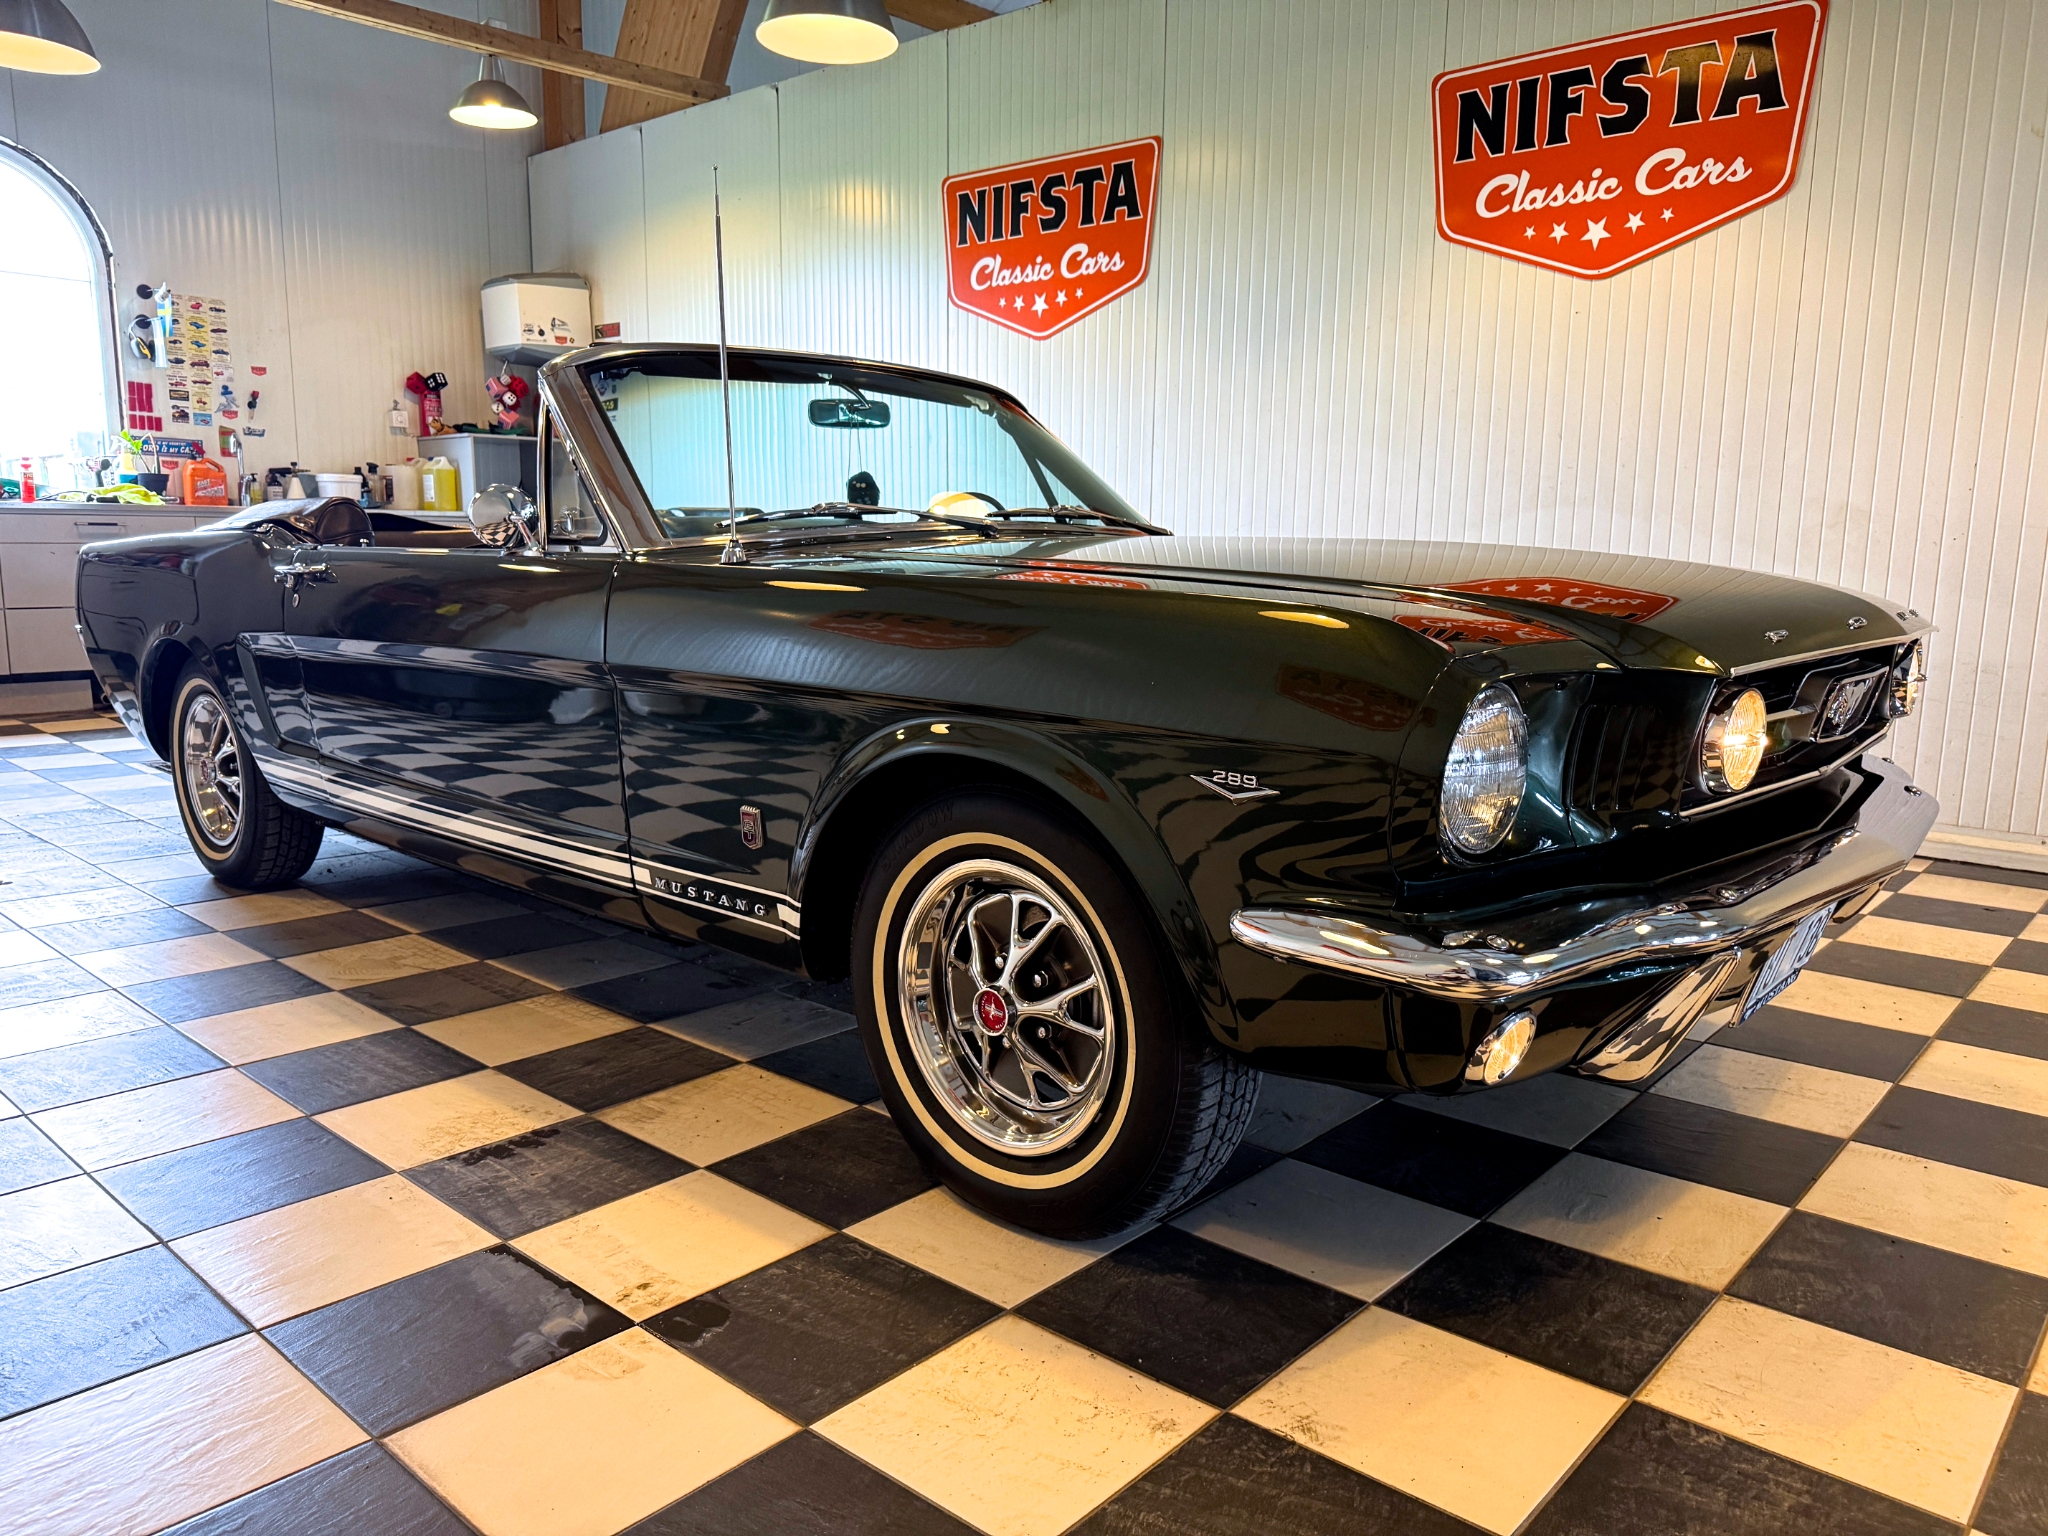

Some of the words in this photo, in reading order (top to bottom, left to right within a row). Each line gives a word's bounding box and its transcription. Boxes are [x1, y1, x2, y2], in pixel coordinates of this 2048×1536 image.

[1453, 28, 1789, 164] NIFSTA
[956, 158, 1143, 248] NIFSTA
[1475, 168, 1622, 218] Classic
[1635, 147, 1753, 196] Cars
[970, 253, 1054, 290] Classic
[1060, 243, 1125, 278] Cars
[1212, 769, 1257, 789] 289
[654, 876, 767, 917] MUSTANG
